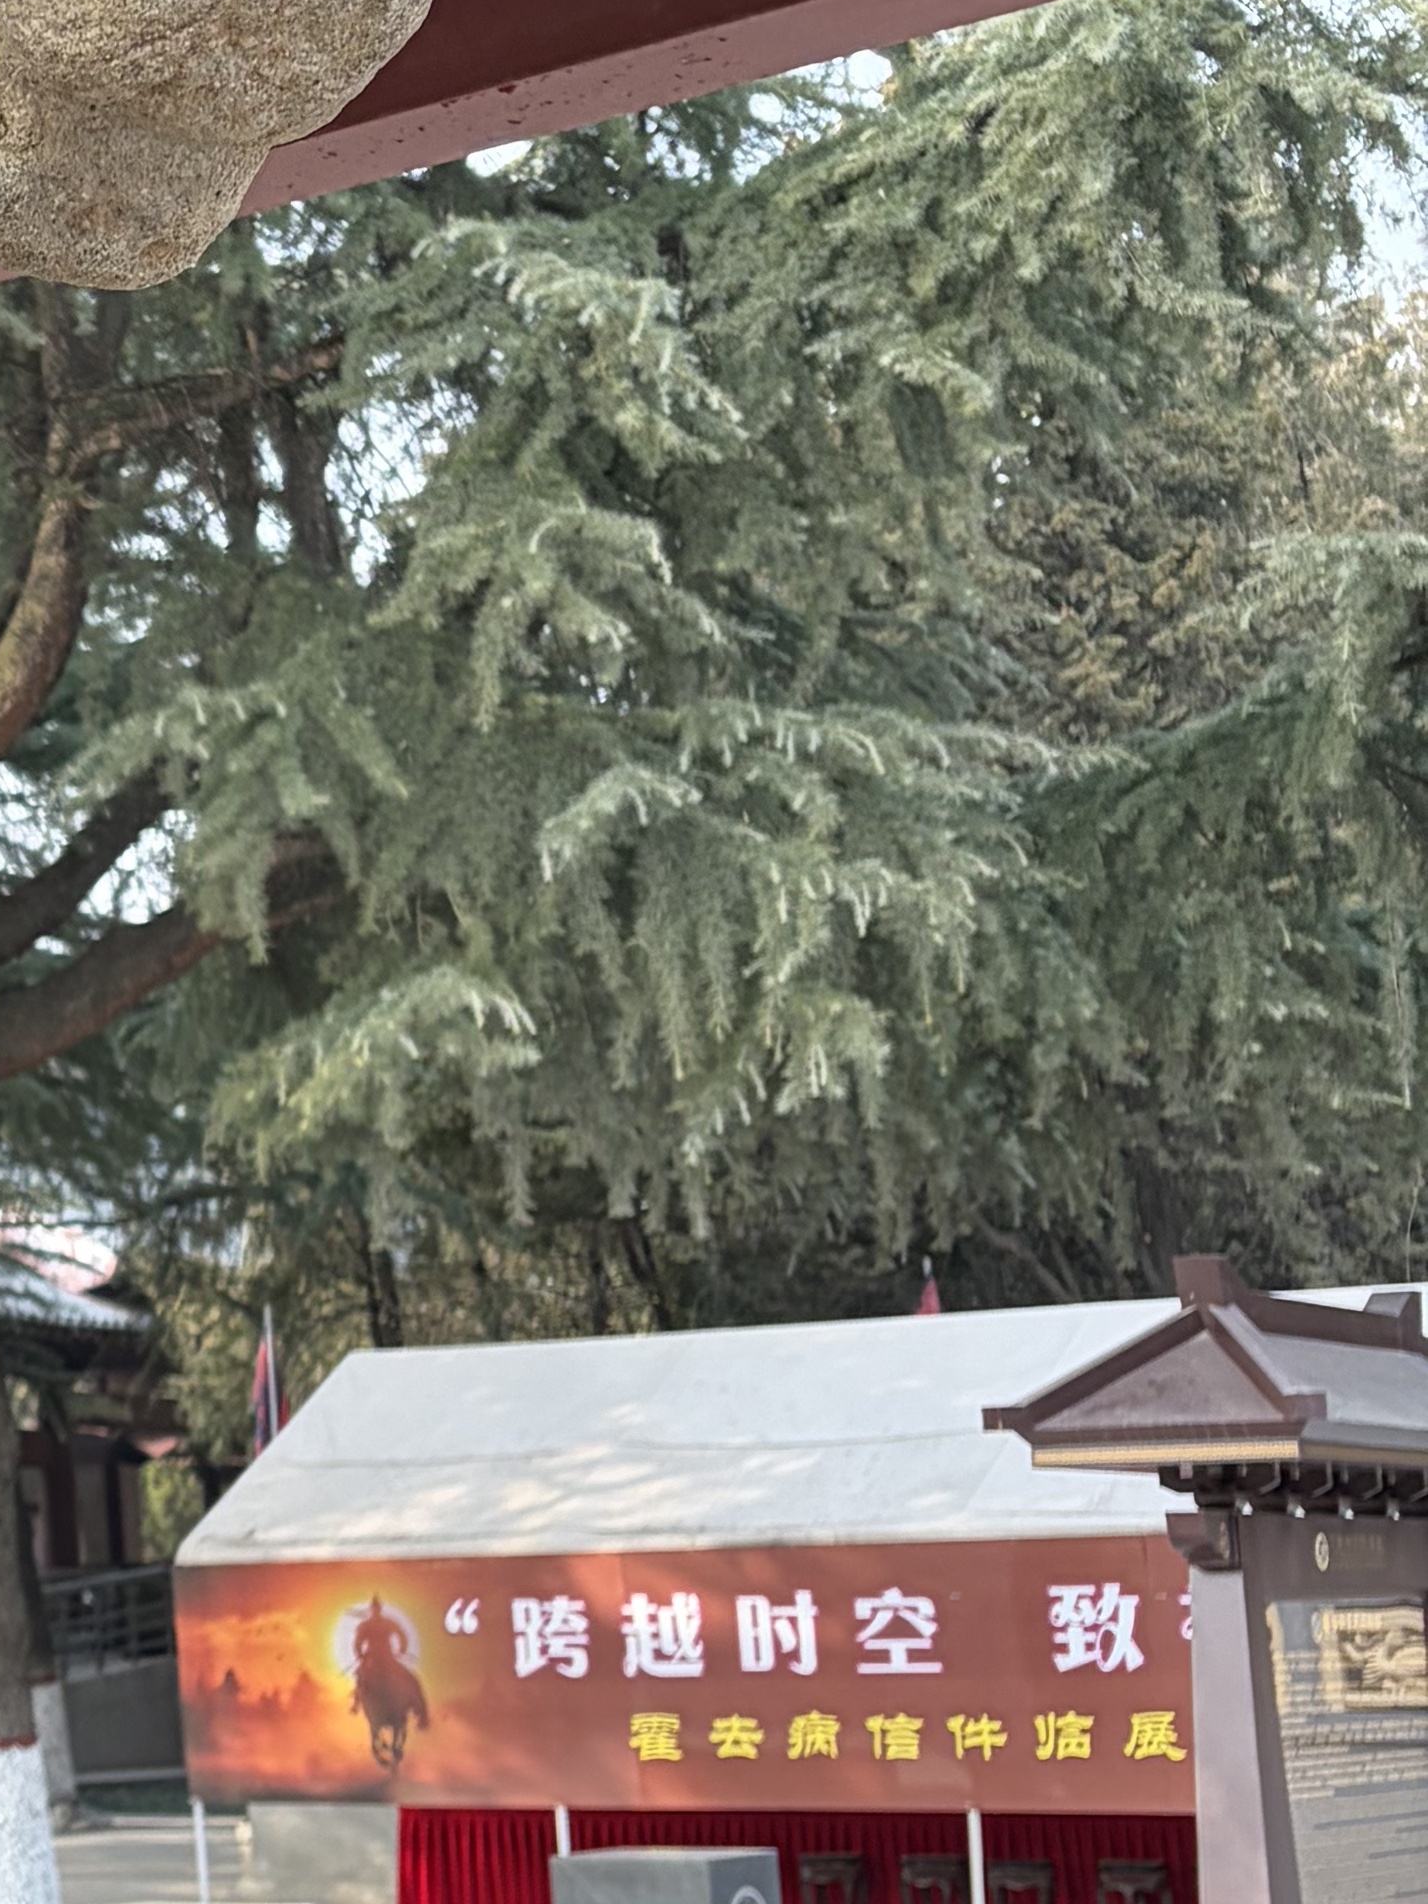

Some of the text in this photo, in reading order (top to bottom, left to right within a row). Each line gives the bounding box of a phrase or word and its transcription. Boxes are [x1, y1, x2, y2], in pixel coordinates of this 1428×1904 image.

[443, 1582, 1192, 1678] “跨越时空 致
[628, 1710, 1188, 1762] 霍去病信件临展
